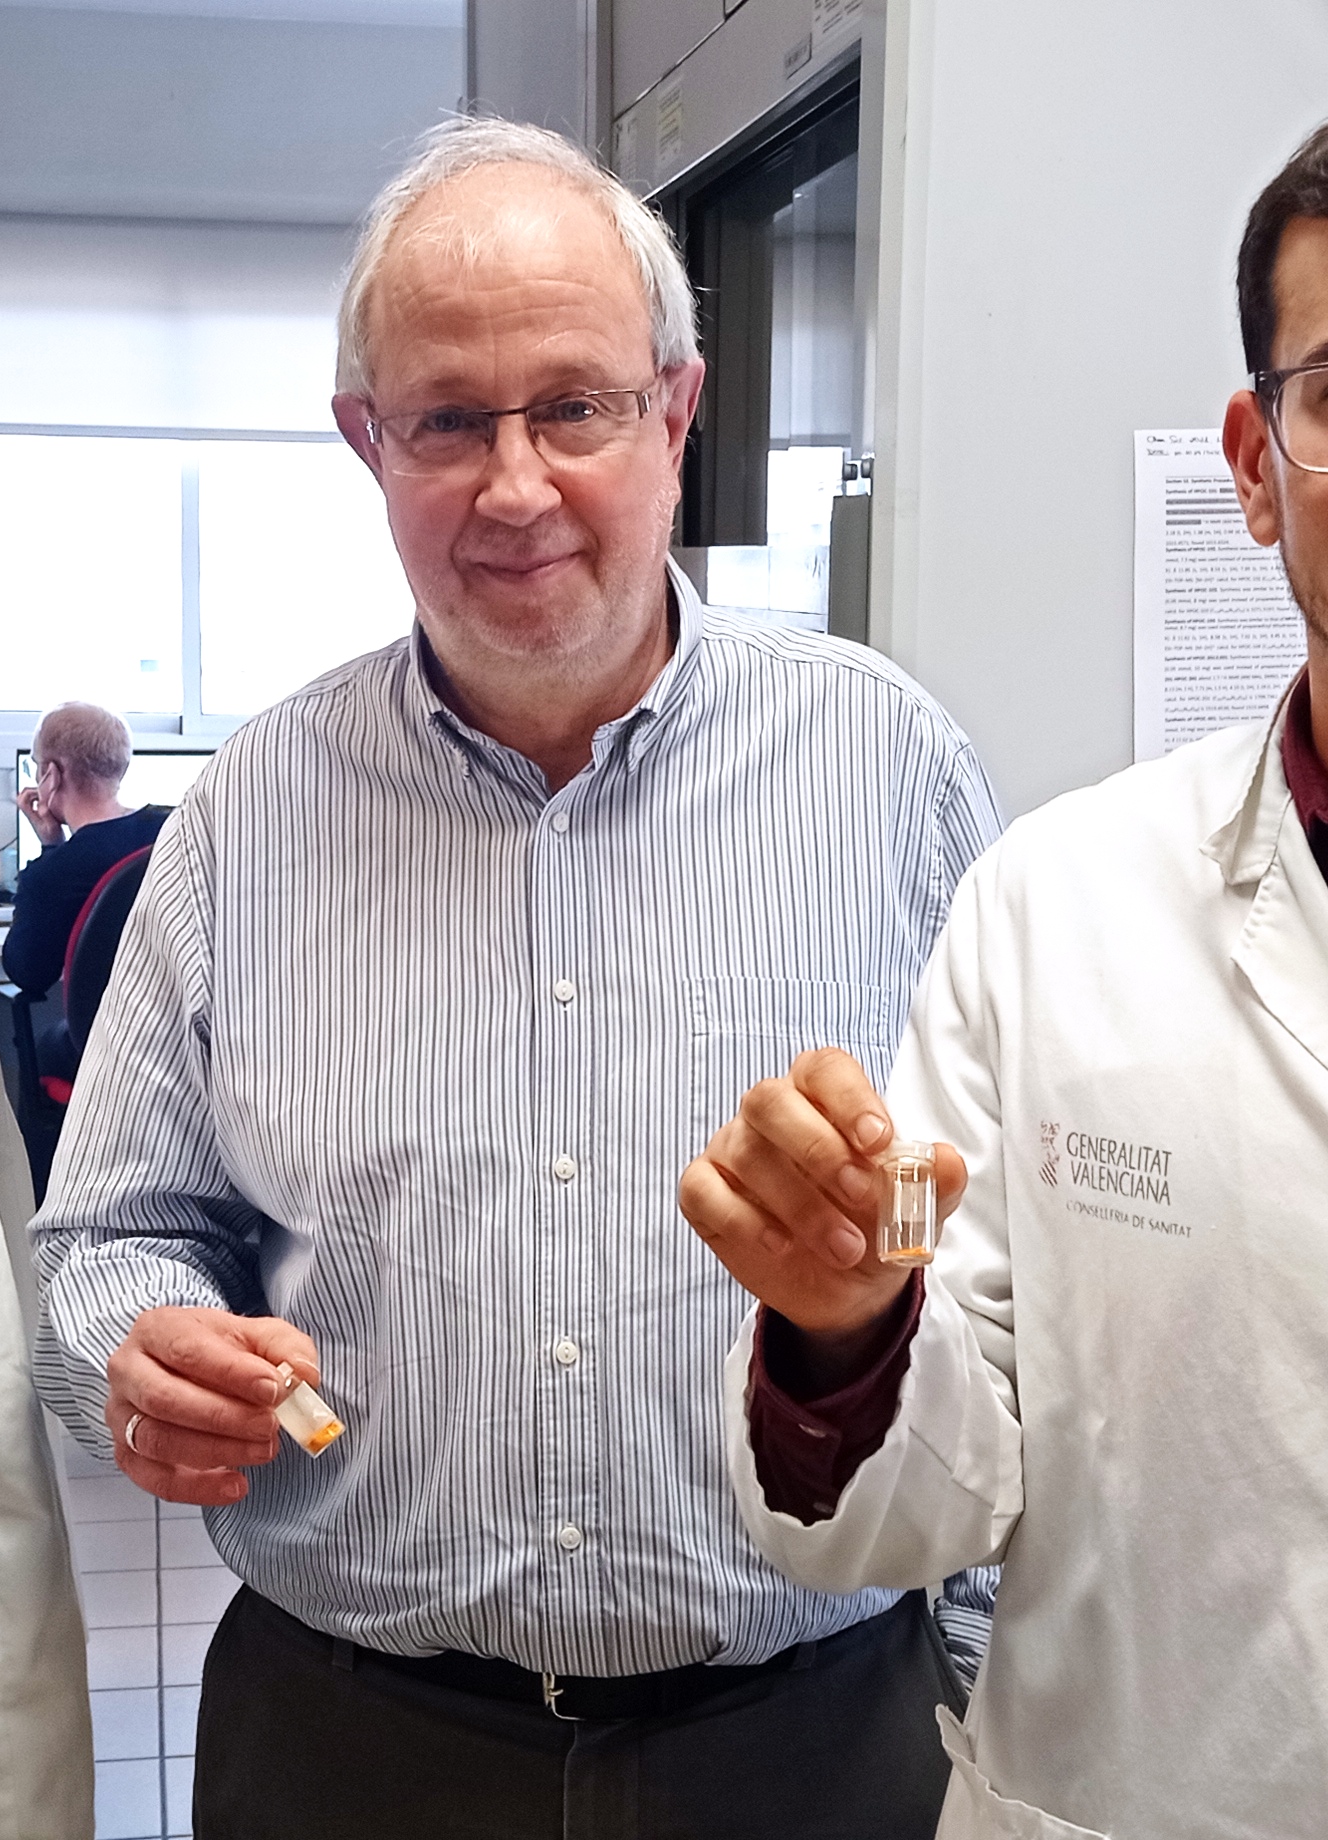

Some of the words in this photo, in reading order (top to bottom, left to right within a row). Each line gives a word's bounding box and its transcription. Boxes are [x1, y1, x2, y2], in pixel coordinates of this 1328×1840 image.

[1066, 1131, 1172, 1178] GENERALITAT
[1070, 1160, 1171, 1207] VALENCIANA
[1132, 1214, 1145, 1230] DE
[1148, 1218, 1193, 1239] SANITAT
